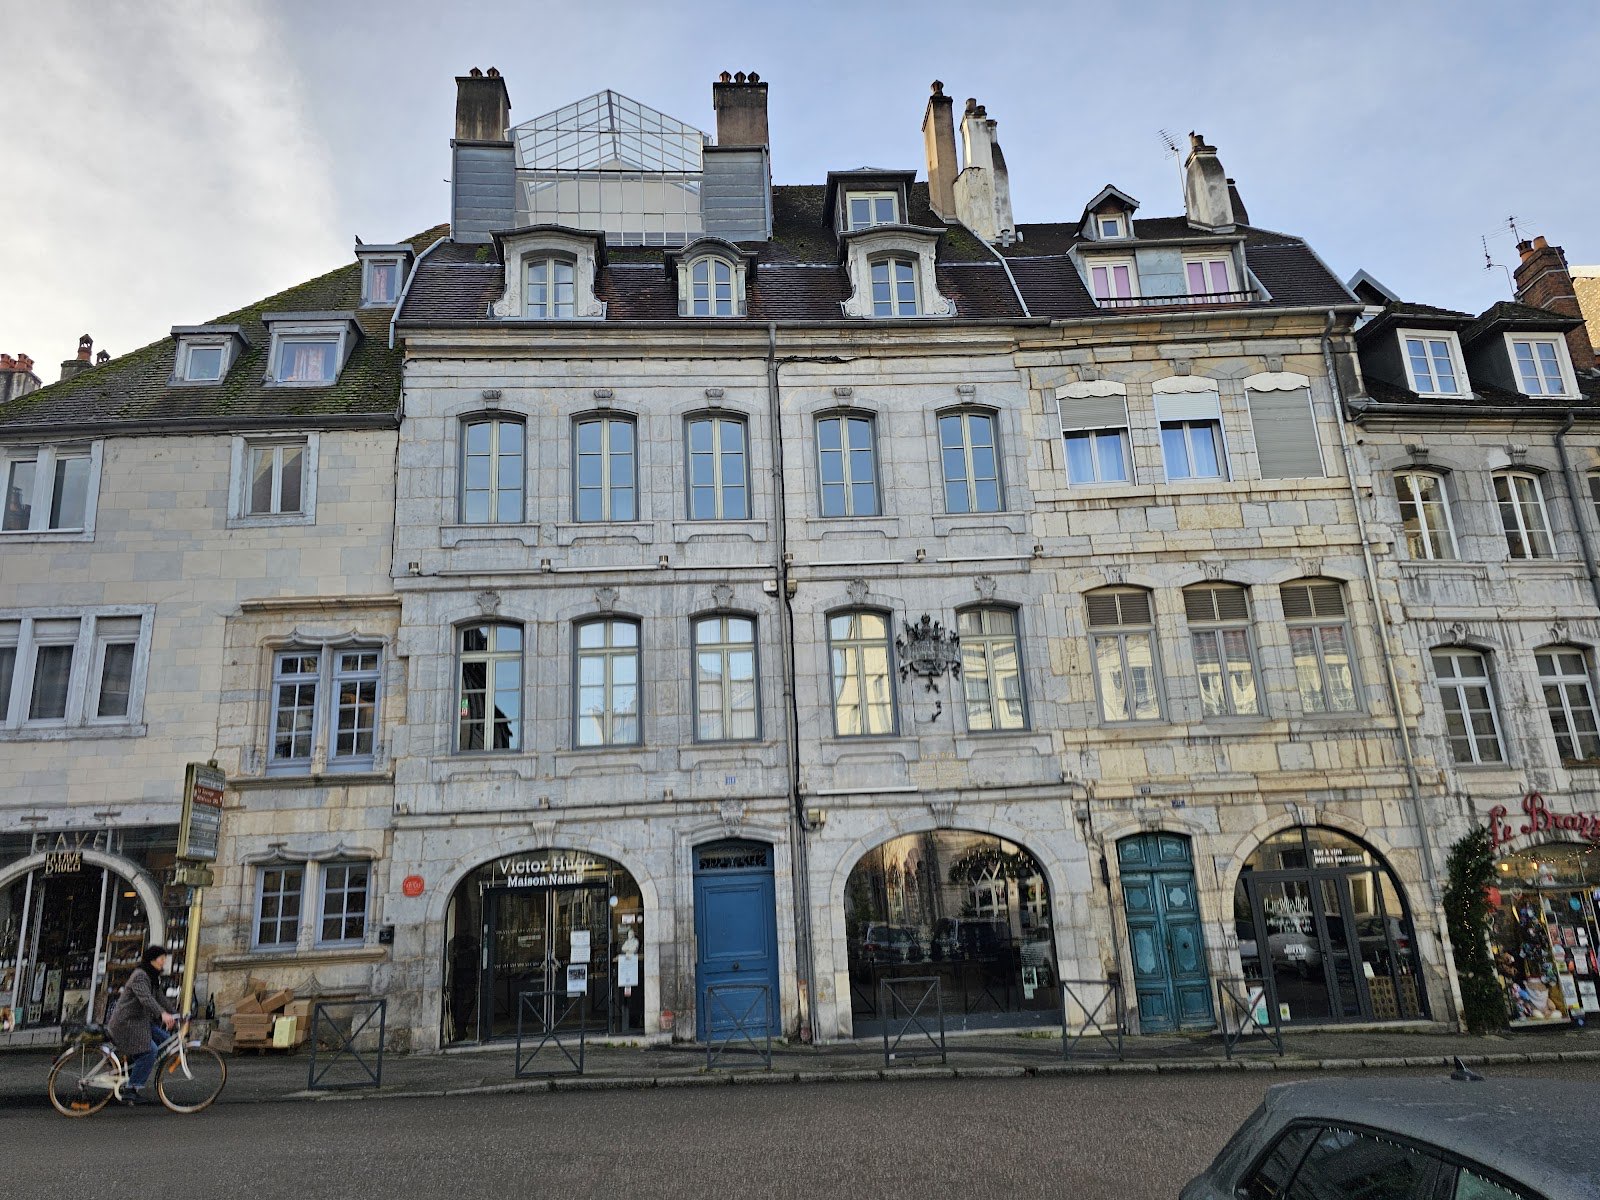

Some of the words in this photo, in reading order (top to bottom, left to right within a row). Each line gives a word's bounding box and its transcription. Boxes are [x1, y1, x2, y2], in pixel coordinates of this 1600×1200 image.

[1489, 805, 1512, 851] Le
[500, 859, 547, 874] Victor
[552, 856, 595, 874] Hugo
[507, 876, 547, 887] Maison
[549, 873, 583, 885] Natale
